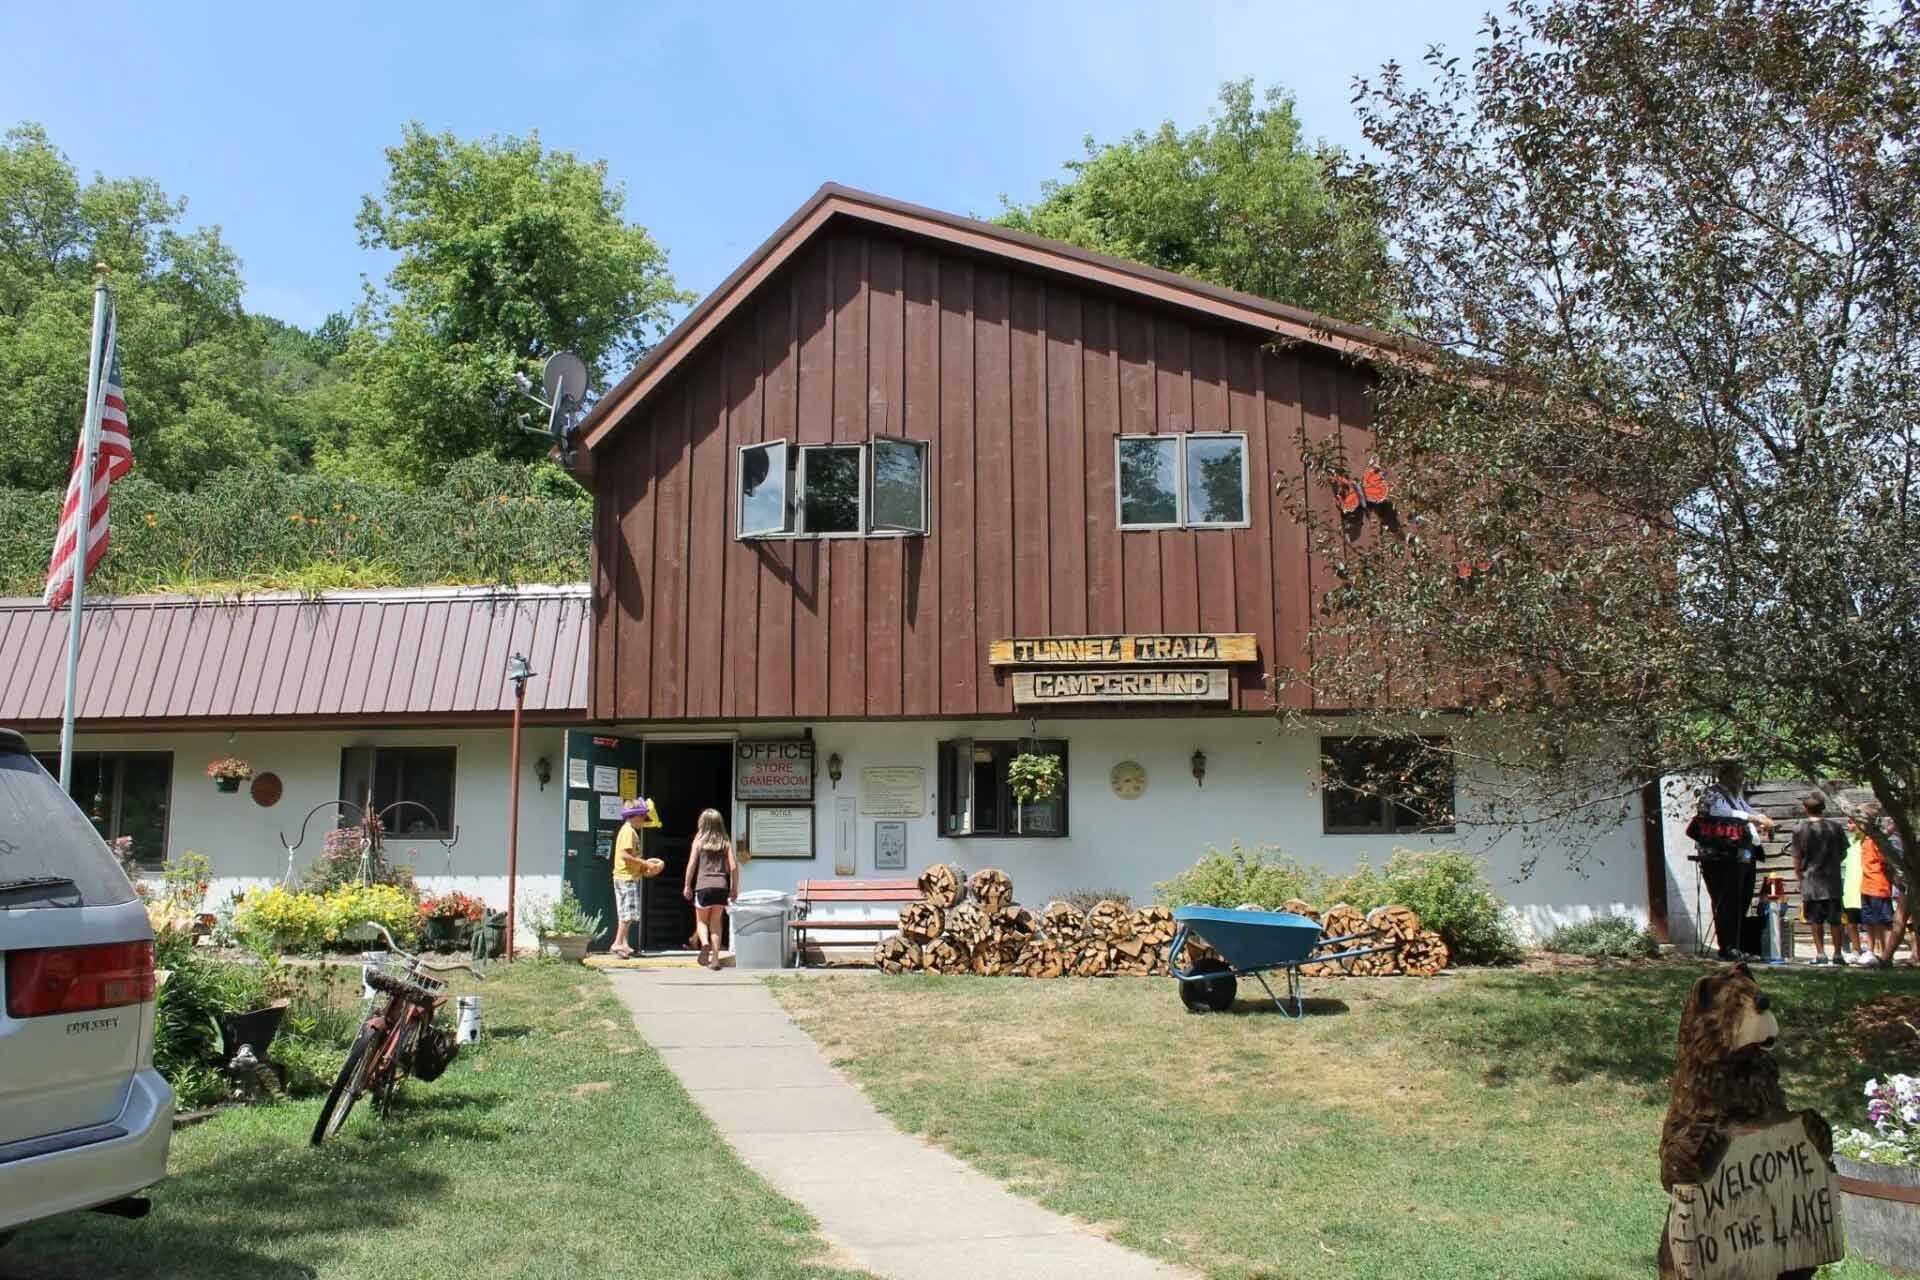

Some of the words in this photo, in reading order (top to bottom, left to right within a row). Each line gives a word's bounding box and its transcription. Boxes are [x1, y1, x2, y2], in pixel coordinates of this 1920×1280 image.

[1014, 639, 1121, 662] TUNNEL
[1134, 636, 1217, 659] TRAIL
[1035, 673, 1209, 697] CAMPGROUND
[739, 743, 811, 760] OFFICE
[755, 762, 792, 773] STORE
[740, 775, 808, 786] GAMEROOM
[1700, 1142, 1814, 1219] WELCOME
[1694, 1233, 1718, 1272] TO
[1724, 1215, 1765, 1253] THE
[1770, 1187, 1833, 1243] LAKE
